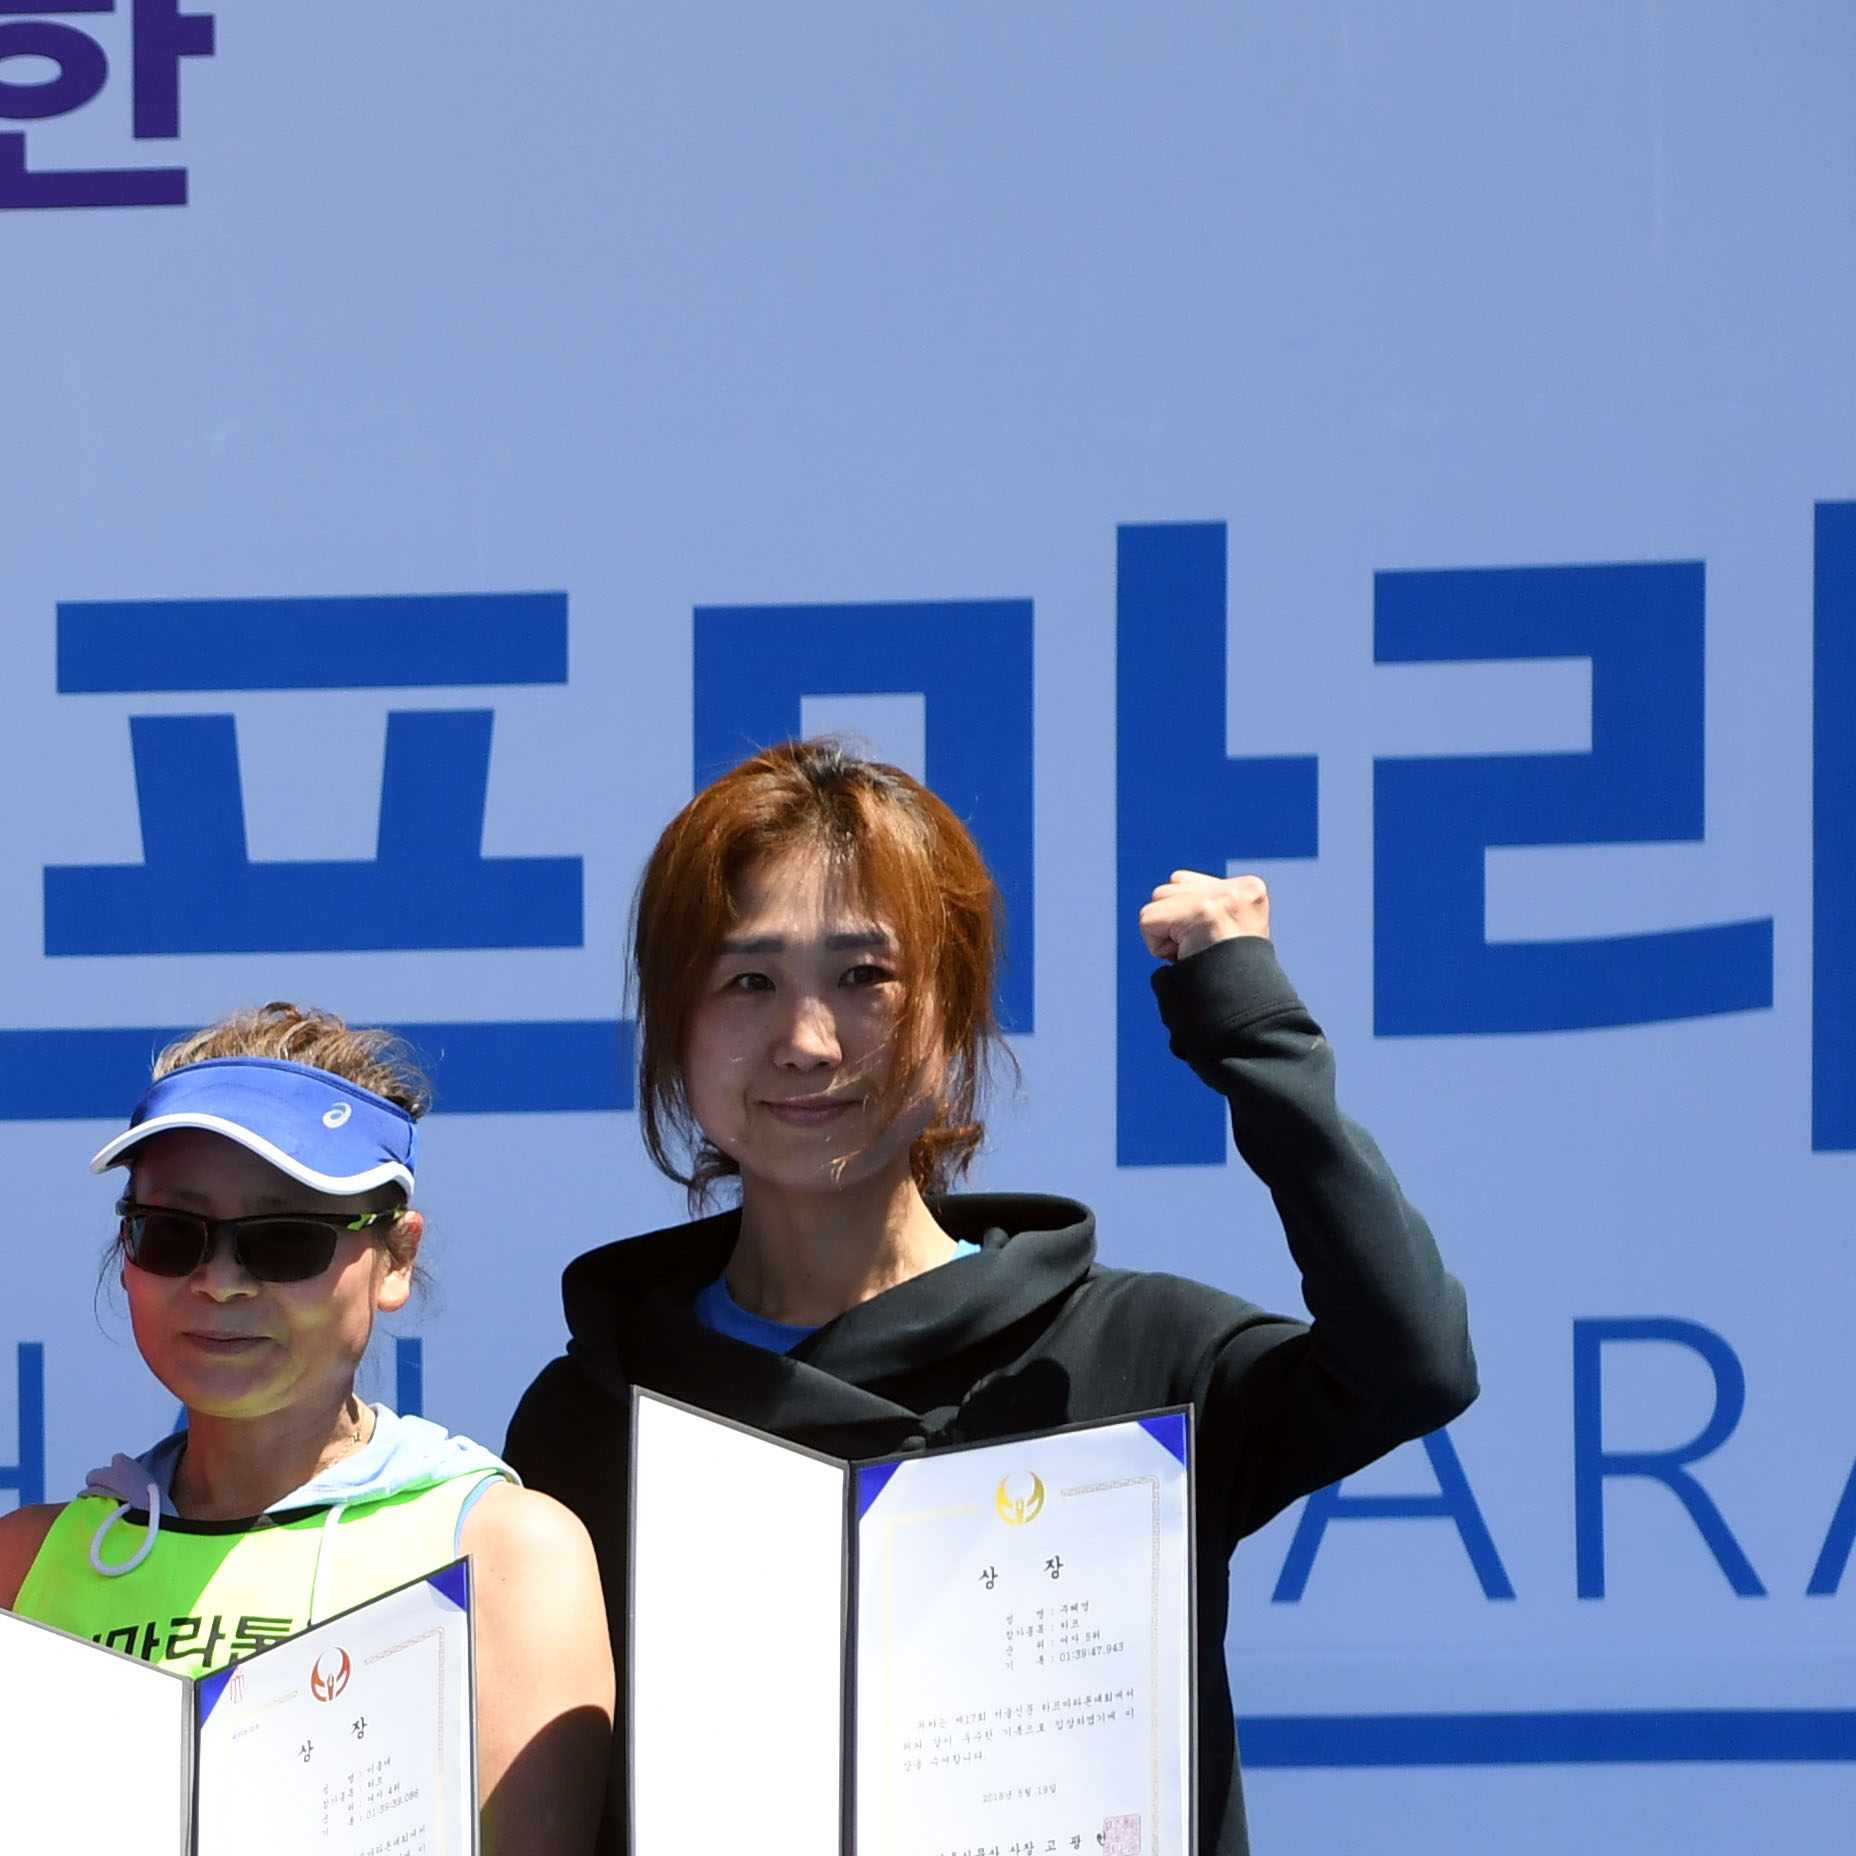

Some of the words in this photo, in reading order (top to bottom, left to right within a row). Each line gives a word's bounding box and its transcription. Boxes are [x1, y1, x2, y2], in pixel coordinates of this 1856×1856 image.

[978, 1565, 999, 1591] 상
[1043, 1555, 1064, 1580] 장
[92, 1615, 294, 1668] 마라톤
[1085, 1628, 1101, 1643] 5위
[995, 1703, 1034, 1721] 서울신문
[1042, 1687, 1135, 1714] 하프마라톤대회에서
[297, 1739, 315, 1763] 상
[350, 1716, 368, 1740] 장
[1010, 1841, 1035, 1856] 사장
[1044, 1838, 1057, 1853] 고
[1069, 1833, 1082, 1851] 광
